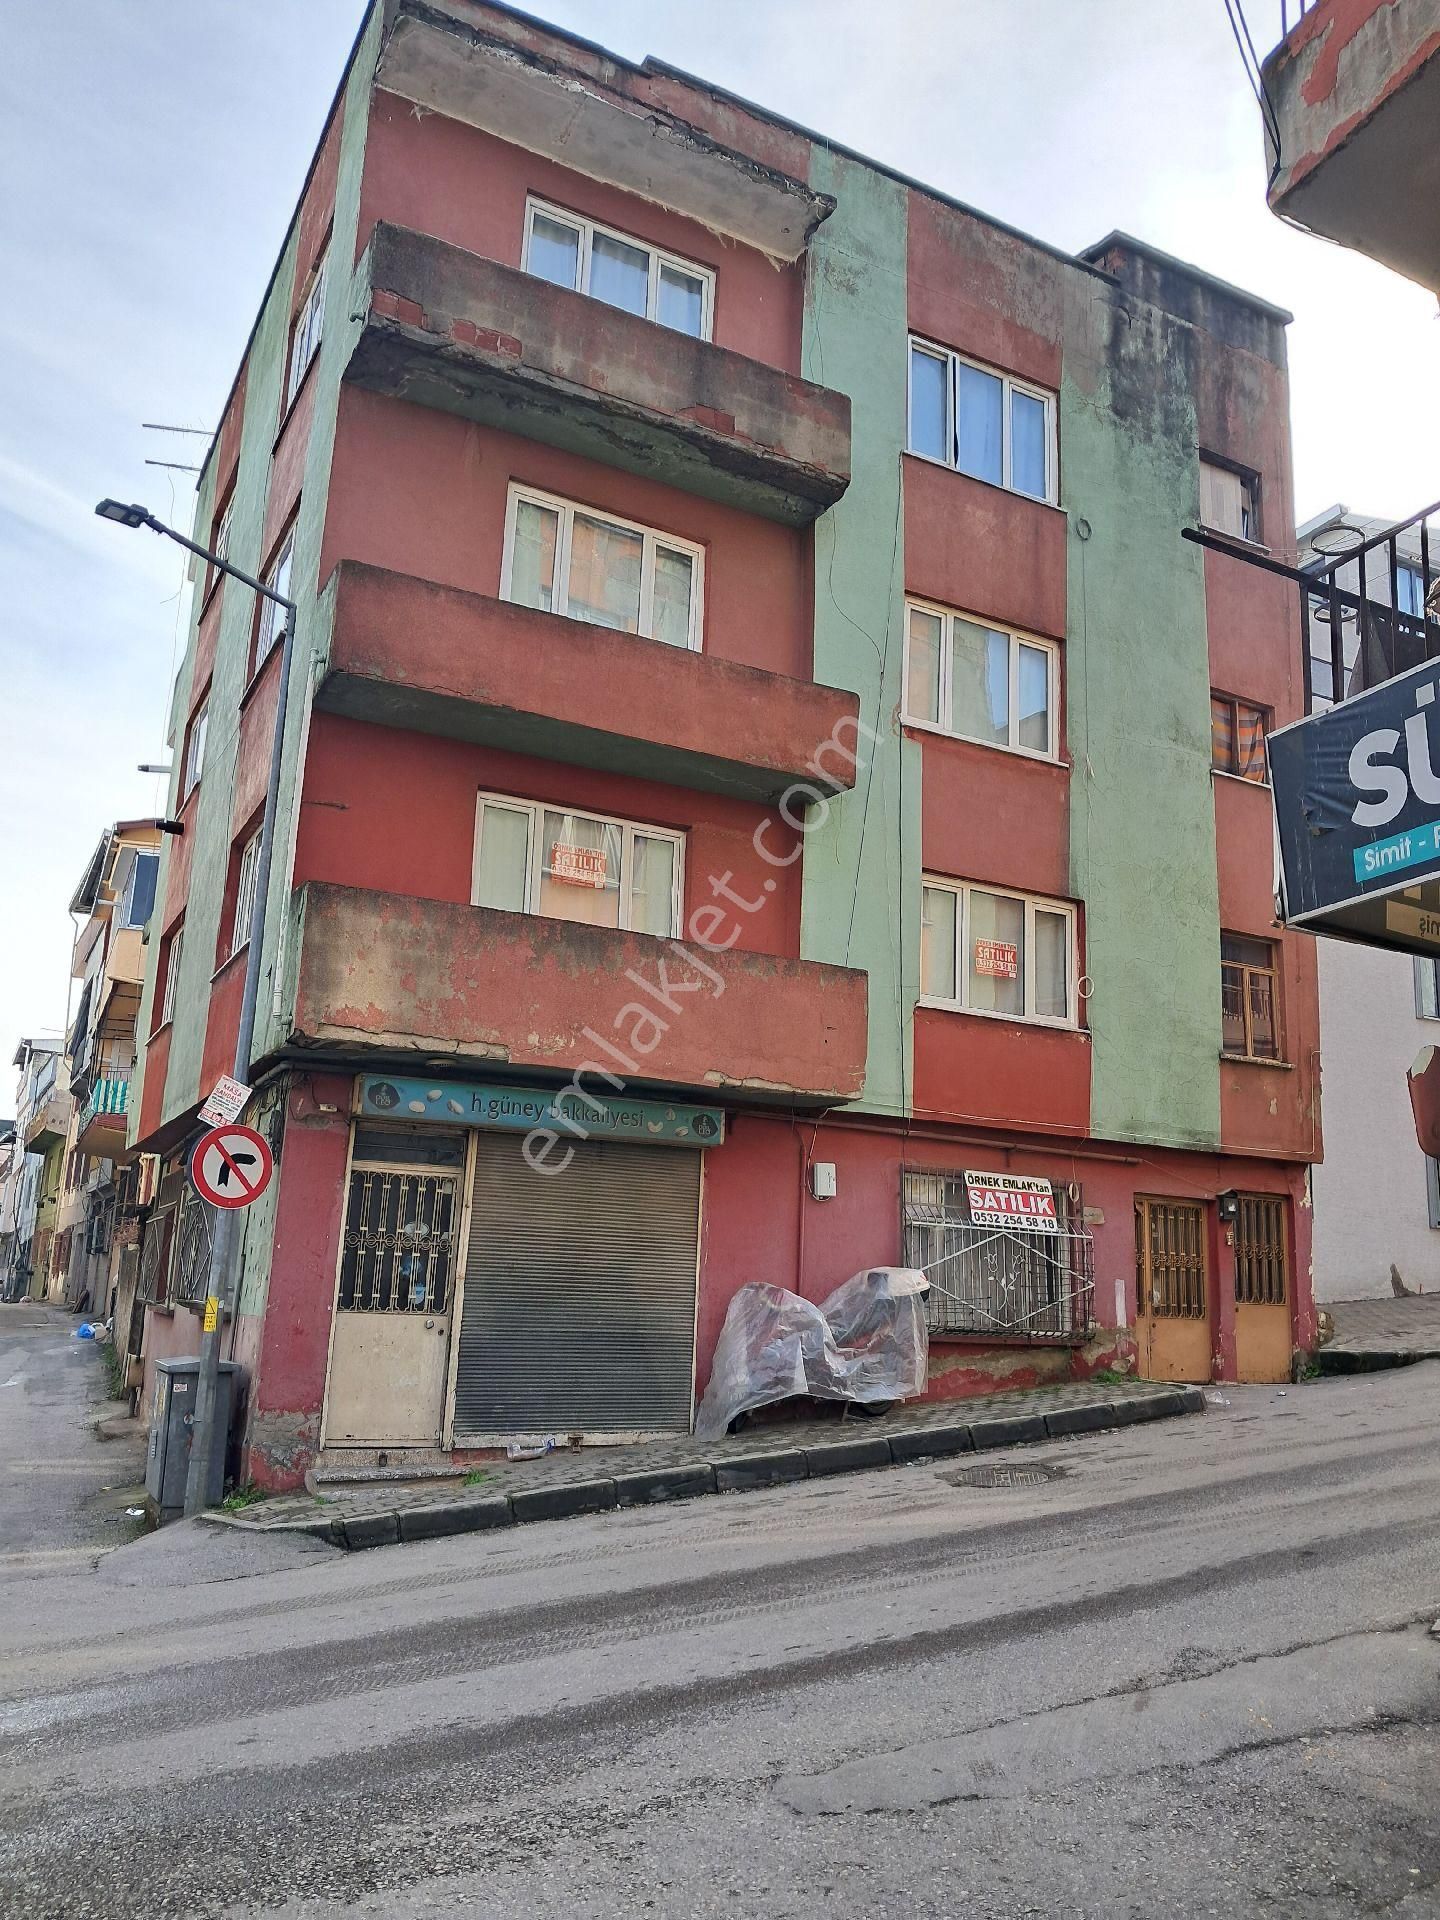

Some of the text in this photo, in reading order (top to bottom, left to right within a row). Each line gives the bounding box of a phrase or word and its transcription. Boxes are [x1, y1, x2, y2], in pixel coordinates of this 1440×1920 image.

[555, 852, 603, 872] SATILIK
[1365, 836, 1411, 871] Simit
[978, 946, 1014, 963] SATILIK
[471, 1093, 545, 1122] h.güney
[967, 1172, 1050, 1193] ÖRNEK EMLAK'tan
[969, 1189, 1053, 1215] SATILIK
[973, 1212, 1055, 1229] 0532 254 58 18
